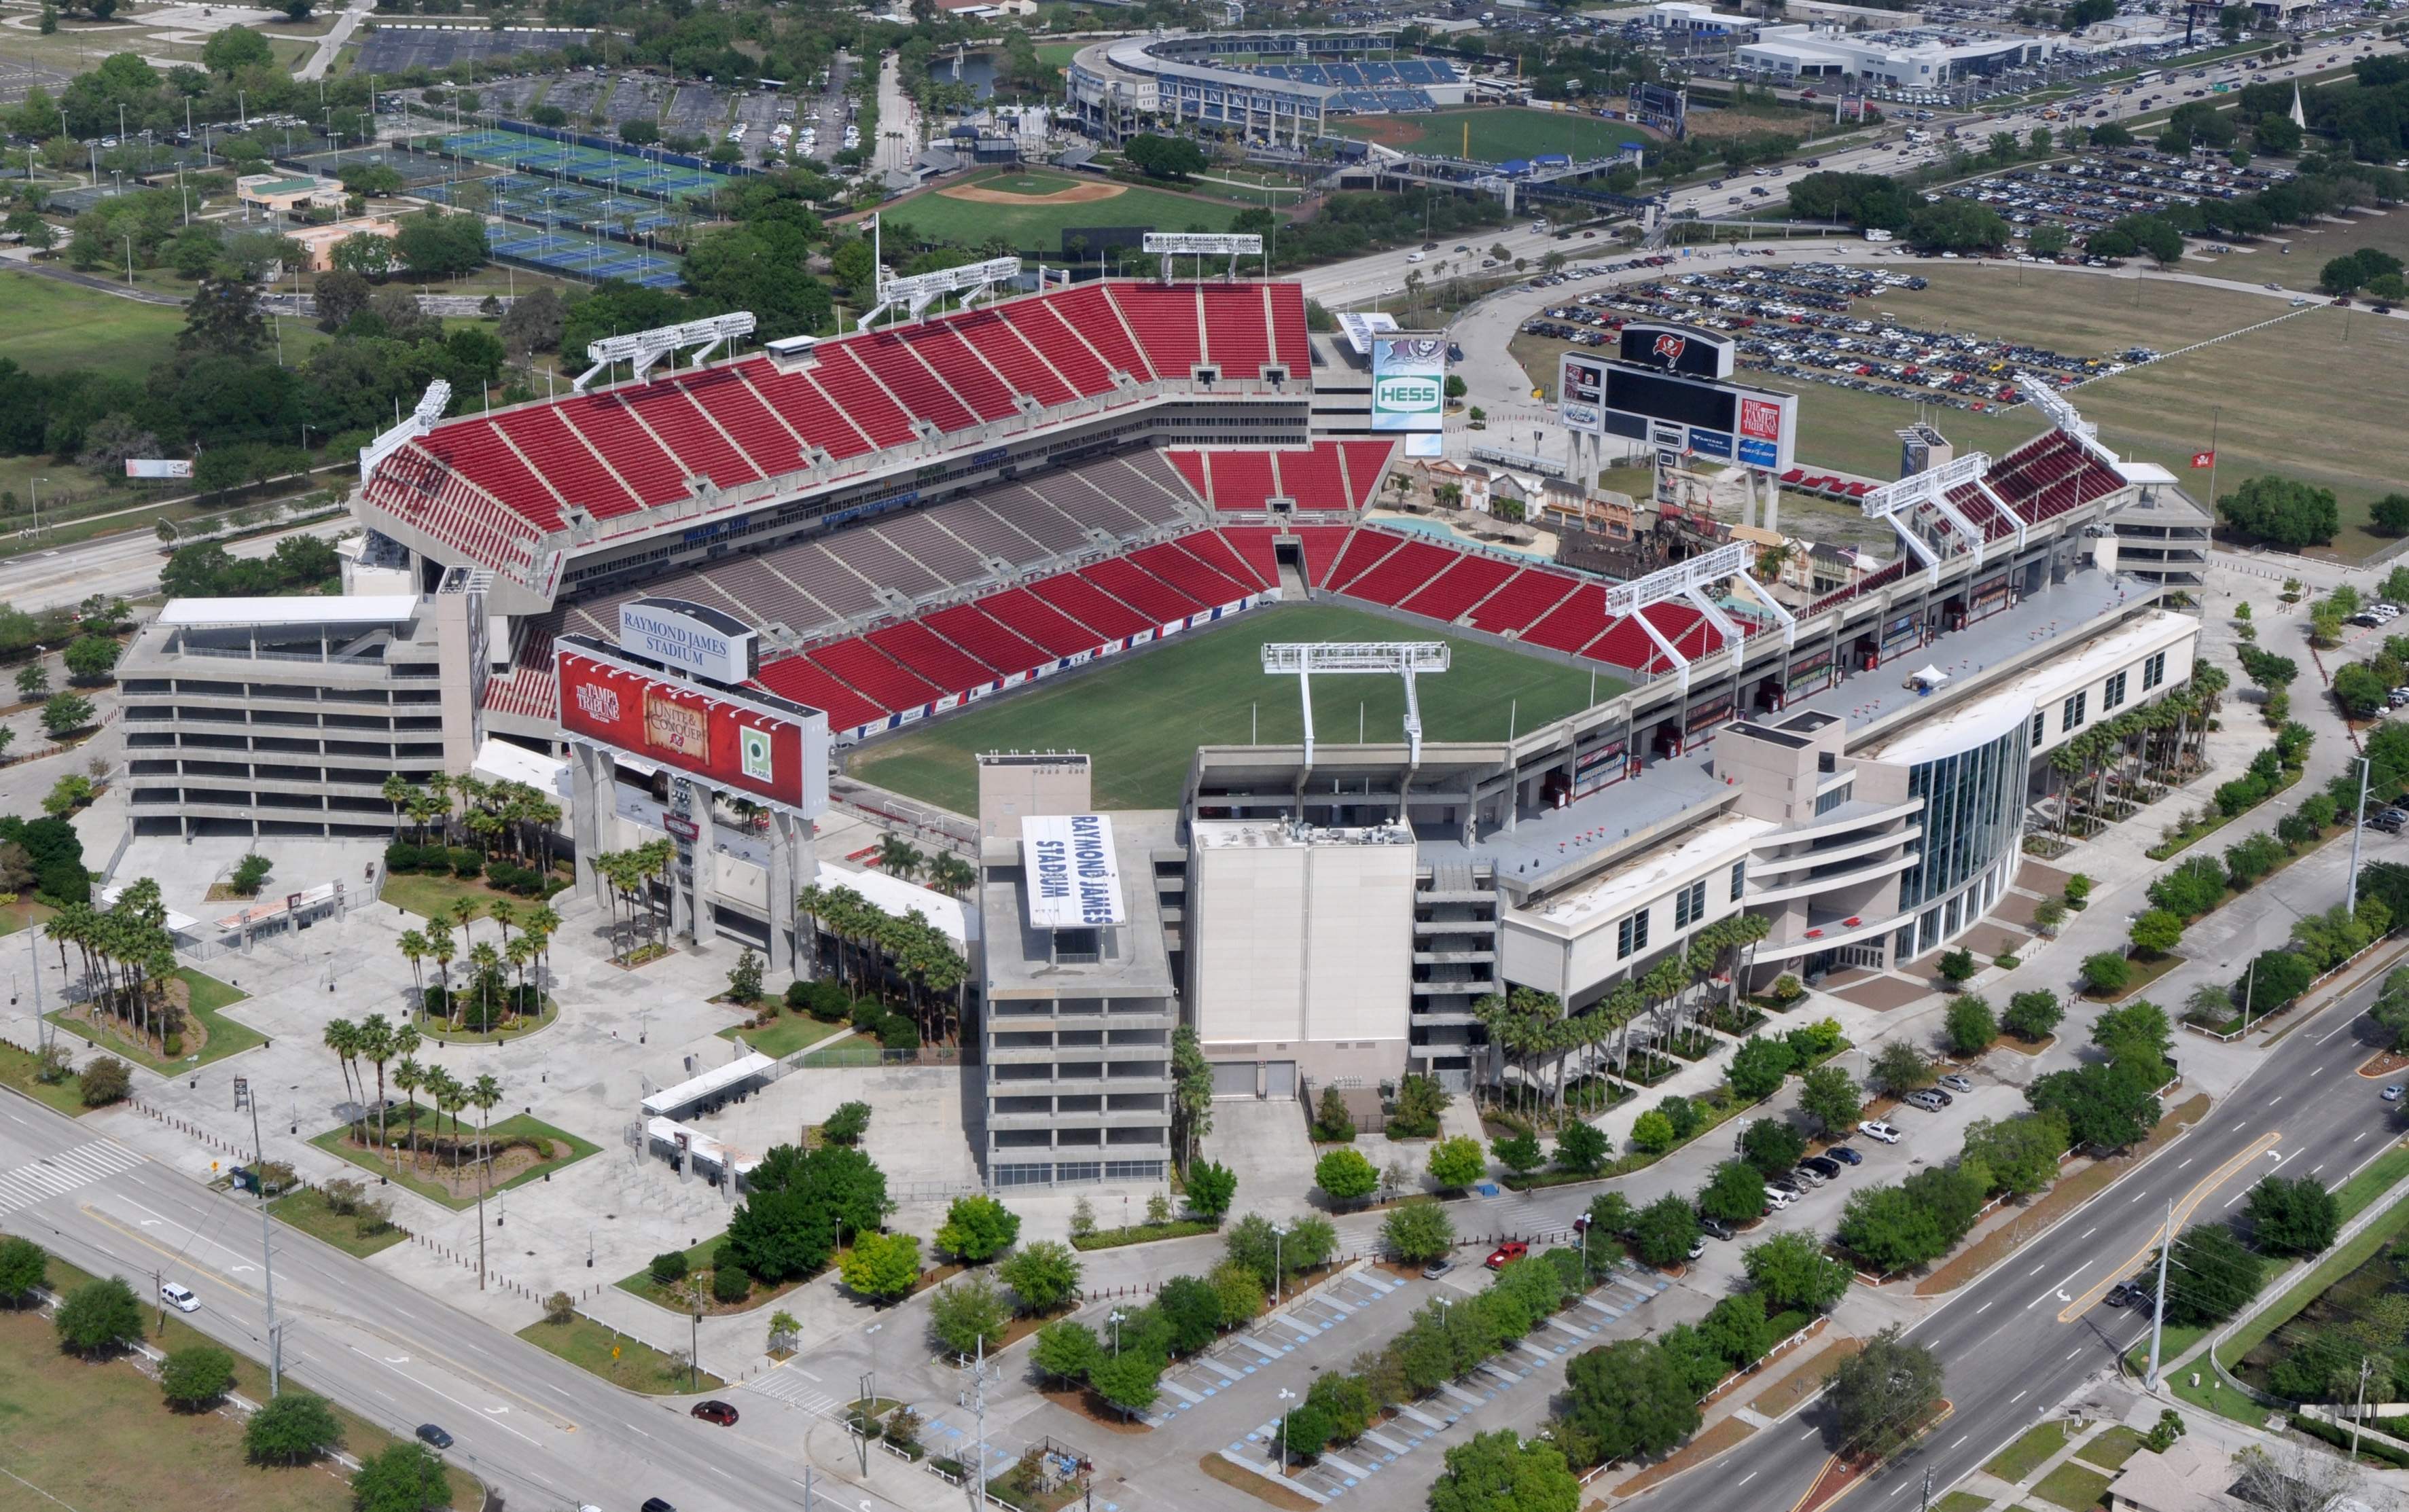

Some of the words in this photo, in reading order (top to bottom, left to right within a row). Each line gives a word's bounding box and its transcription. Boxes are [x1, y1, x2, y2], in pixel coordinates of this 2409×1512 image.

[1218, 39, 1382, 52] YANEES
[1164, 84, 1314, 117] YANKEES
[1381, 387, 1435, 401] HESS
[1744, 400, 1761, 412] THE
[1744, 409, 1777, 426] TAMPA
[1743, 420, 1777, 435] TRIBUNE
[973, 449, 1007, 465] GEICO
[624, 612, 686, 642] RAYMOND
[686, 631, 727, 655] JAMES
[646, 636, 703, 665] STADIUM
[576, 685, 587, 696] THE
[586, 683, 620, 706] TAMPA
[577, 694, 620, 719] TRIBUNE
[689, 713, 696, 726] &
[1071, 816, 1106, 878] RAYMOND
[1035, 841, 1070, 898] STADIUM
[1079, 881, 1113, 924] JAMES
